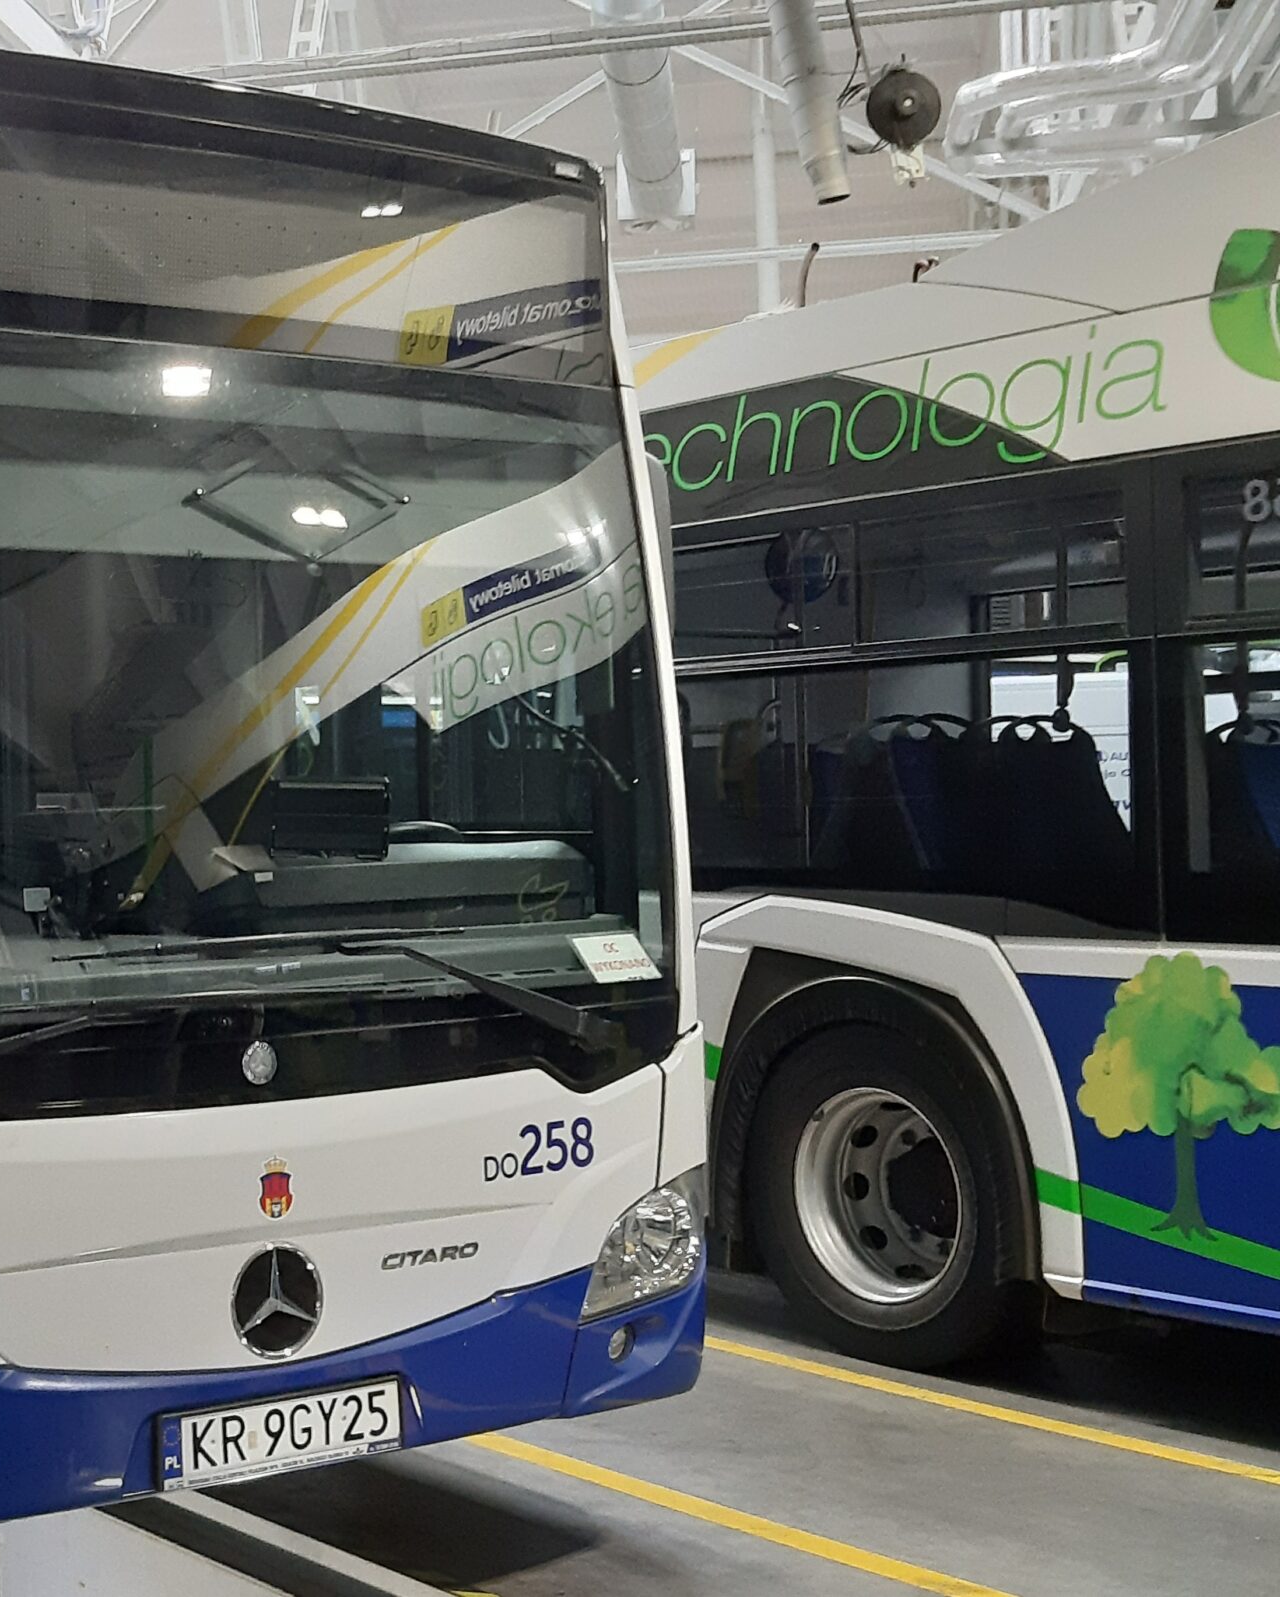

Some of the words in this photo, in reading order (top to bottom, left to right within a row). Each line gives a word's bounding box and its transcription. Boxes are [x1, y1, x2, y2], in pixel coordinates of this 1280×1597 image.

[1243, 478, 1280, 522] 8
[380, 1241, 479, 1271] CITARO
[191, 1414, 248, 1471] KR
[264, 1389, 389, 1458] 9GY25
[164, 1456, 181, 1471] PL
